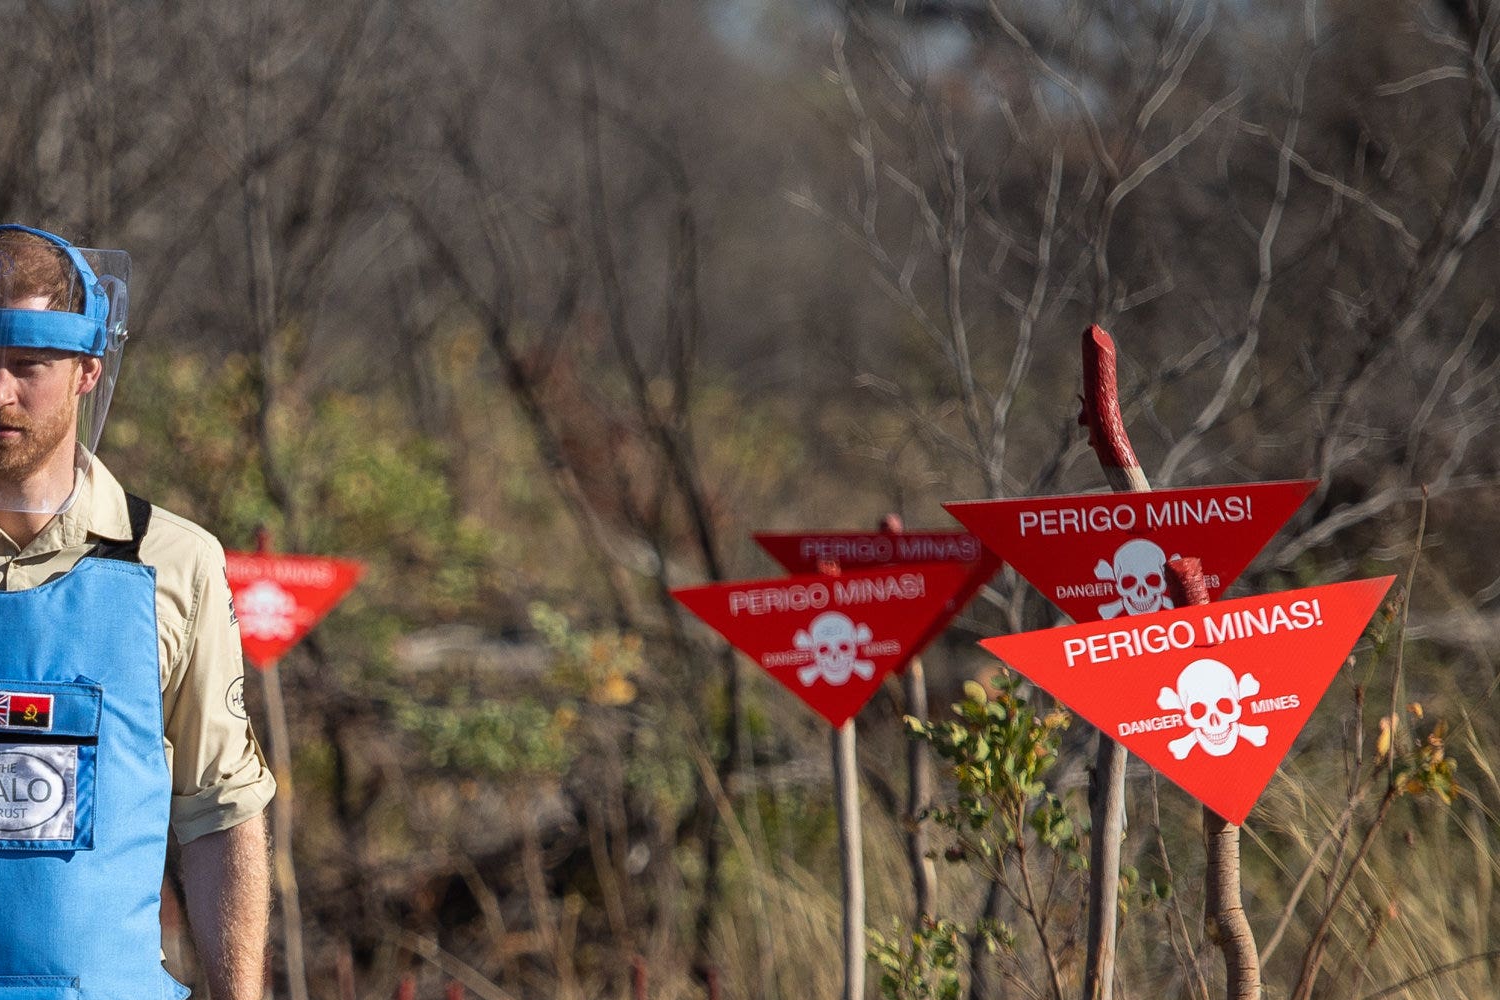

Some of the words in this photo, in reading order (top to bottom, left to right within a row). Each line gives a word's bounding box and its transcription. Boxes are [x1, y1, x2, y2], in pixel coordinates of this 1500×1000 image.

[1019, 503, 1137, 537] PERIGO
[1145, 495, 1253, 528] MINAS!
[729, 582, 830, 617] PERIGO
[833, 573, 926, 606] MINAS!
[1056, 582, 1115, 600] DANGER
[1063, 619, 1196, 668] PERIGO
[1203, 598, 1324, 645] MINAS!
[1117, 712, 1185, 737] DANGER
[1250, 693, 1301, 715] MINES
